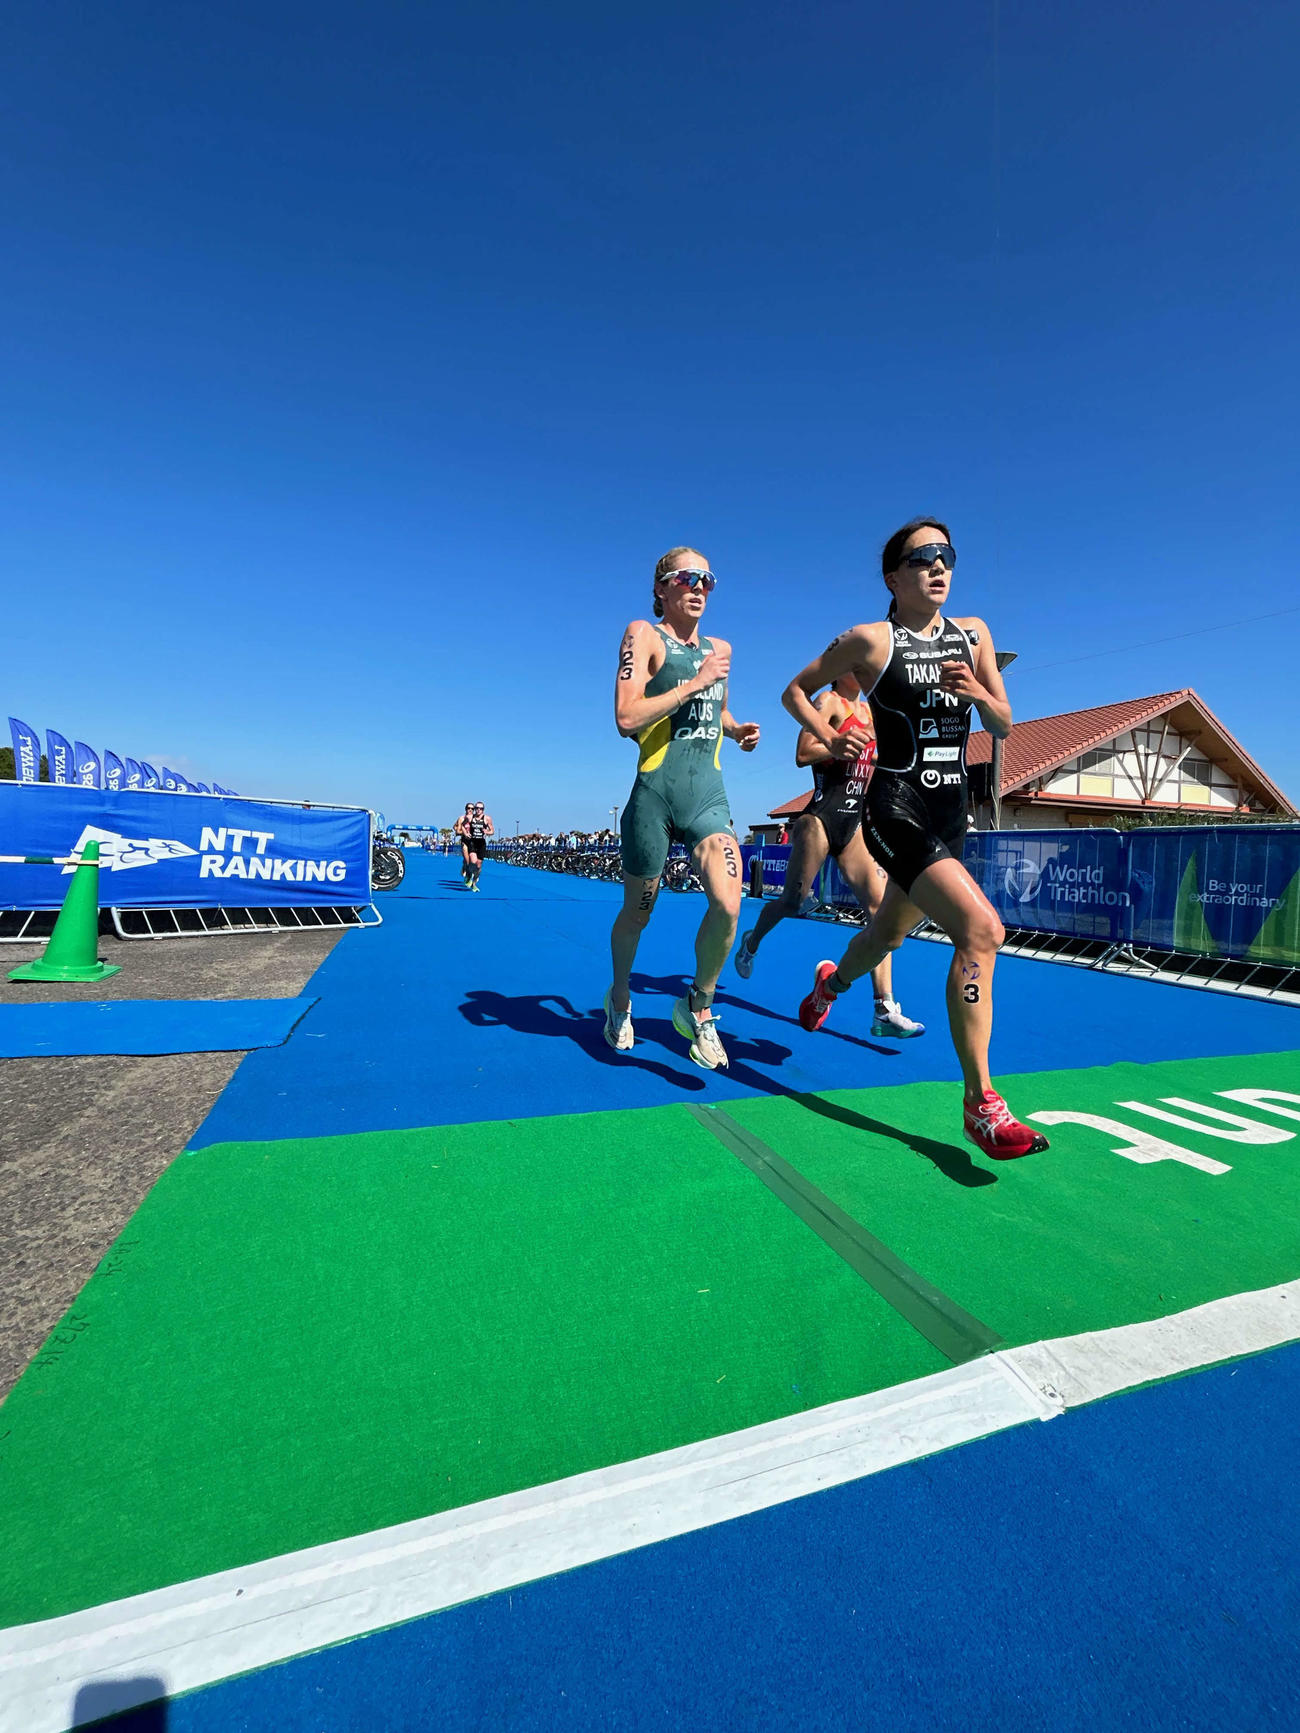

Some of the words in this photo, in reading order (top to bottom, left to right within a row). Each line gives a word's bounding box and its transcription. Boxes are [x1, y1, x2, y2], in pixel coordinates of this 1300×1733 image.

[919, 648, 962, 658] SUBARU
[920, 689, 958, 708] JPN
[688, 703, 713, 721] AUS
[674, 727, 719, 739] QAS
[846, 780, 864, 795] CHN
[199, 827, 275, 855] NTT
[199, 854, 347, 882] RANKING
[1048, 864, 1104, 883] World
[1047, 883, 1131, 907] Triathlon
[1208, 880, 1227, 891] Be
[1229, 882, 1263, 895] your
[1189, 891, 1286, 911] extraordinary
[963, 984, 980, 1004] 3
